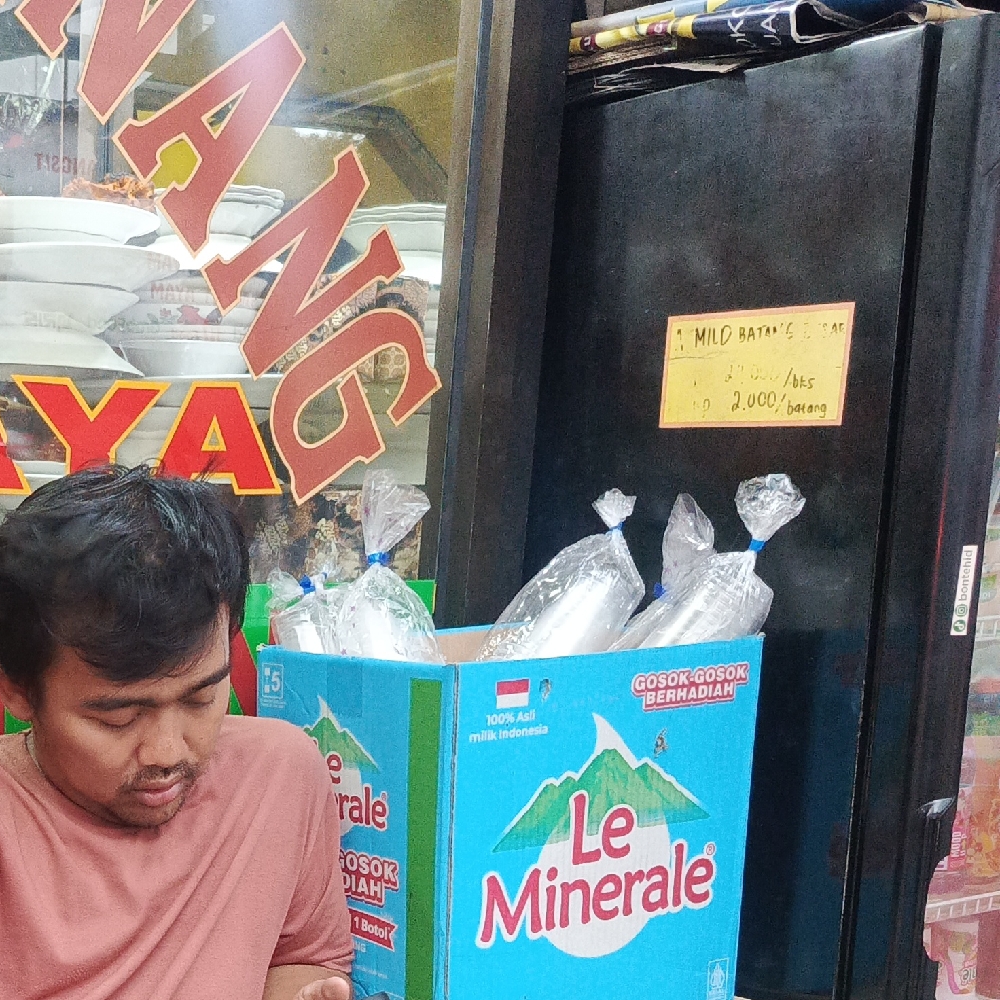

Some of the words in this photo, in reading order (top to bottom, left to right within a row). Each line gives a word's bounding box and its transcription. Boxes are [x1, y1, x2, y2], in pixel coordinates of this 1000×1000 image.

[695, 325, 732, 347] MILD
[958, 550, 973, 602] bontehid
[634, 663, 748, 691] GOSOK-GOSOK
[645, 682, 735, 705] BERHADIAH
[486, 711, 515, 726] 100%
[517, 710, 536, 723] Asli
[469, 730, 497, 742] milik
[499, 724, 548, 741] Indonesia
[335, 786, 388, 830] rale
[572, 793, 635, 866] Le
[480, 843, 715, 943] Minerale
[361, 919, 389, 941] Botol
